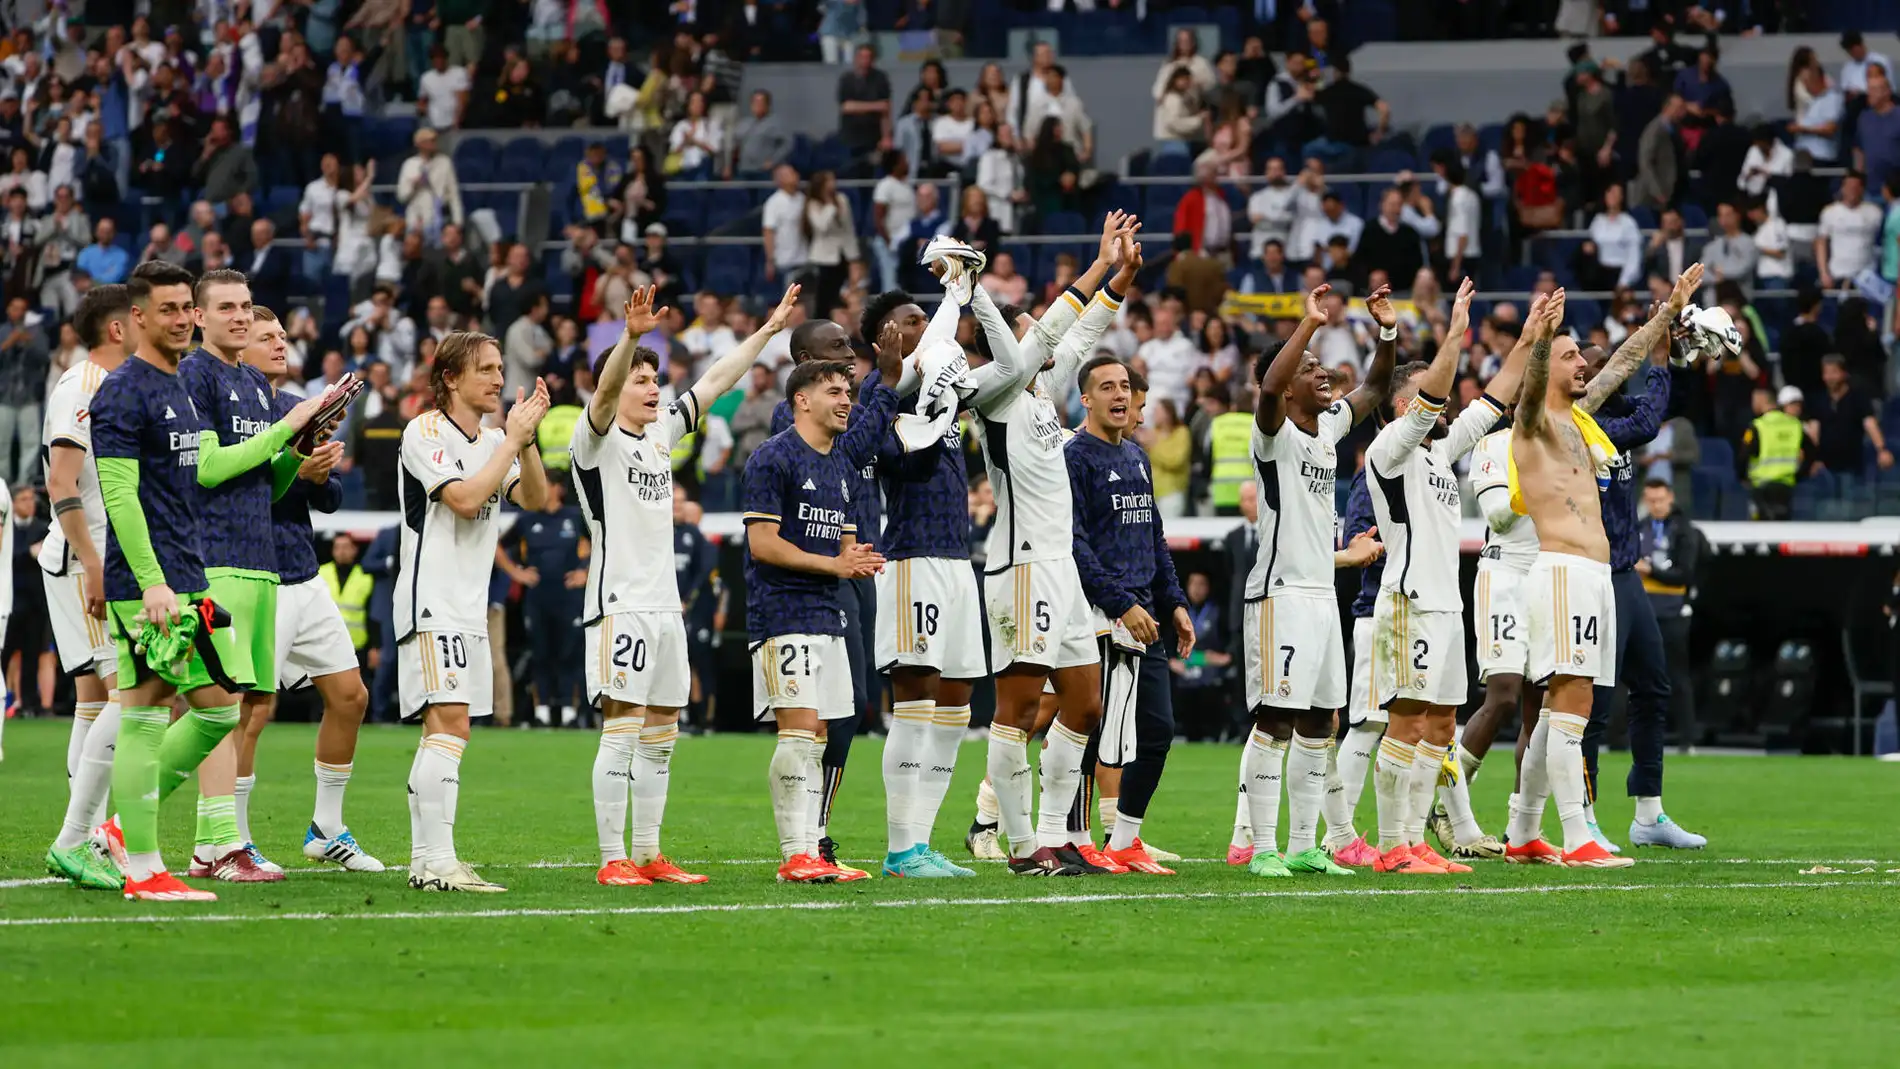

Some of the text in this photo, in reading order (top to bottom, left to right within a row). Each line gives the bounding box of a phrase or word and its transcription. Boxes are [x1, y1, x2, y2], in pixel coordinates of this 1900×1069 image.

[805, 523, 841, 540] FLY BETTE
[913, 601, 939, 636] 18
[1035, 600, 1050, 632] 5
[1491, 614, 1516, 641] 12
[1572, 616, 1597, 645] 14
[437, 635, 467, 668] 10
[613, 634, 646, 672] 20
[780, 644, 811, 676] 21
[1280, 645, 1295, 676] 7
[1414, 639, 1428, 670] 2
